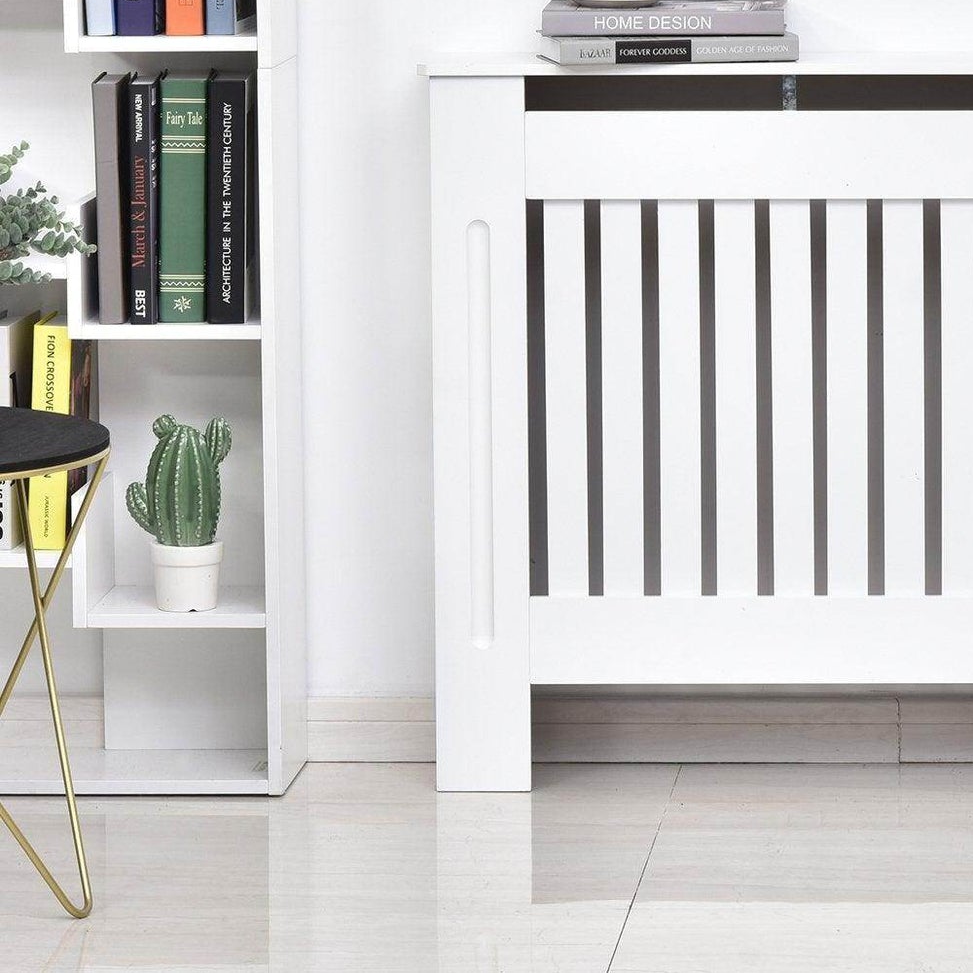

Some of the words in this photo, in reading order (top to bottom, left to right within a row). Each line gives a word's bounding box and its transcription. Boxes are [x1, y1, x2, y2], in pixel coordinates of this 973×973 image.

[594, 16, 644, 29] HOME
[649, 16, 712, 29] DESIGN
[619, 48, 650, 56] FOREVER
[653, 47, 687, 55] GODDESS
[696, 47, 727, 55] GOLDEN
[728, 46, 745, 54] AGE
[757, 45, 789, 53] FASHION
[166, 112, 185, 128] Fairy
[186, 111, 202, 126] Tale
[223, 102, 232, 145] CENTURY
[130, 155, 147, 208] January
[223, 146, 232, 197] TWENTIETH
[131, 211, 146, 222] &
[223, 201, 231, 217] THE
[223, 222, 231, 232] IN
[131, 225, 146, 268] March
[222, 236, 232, 304] ARCHITECTURE
[134, 290, 146, 317] BEST
[48, 335, 56, 358] FION
[46, 361, 55, 411] CROSSOVE
